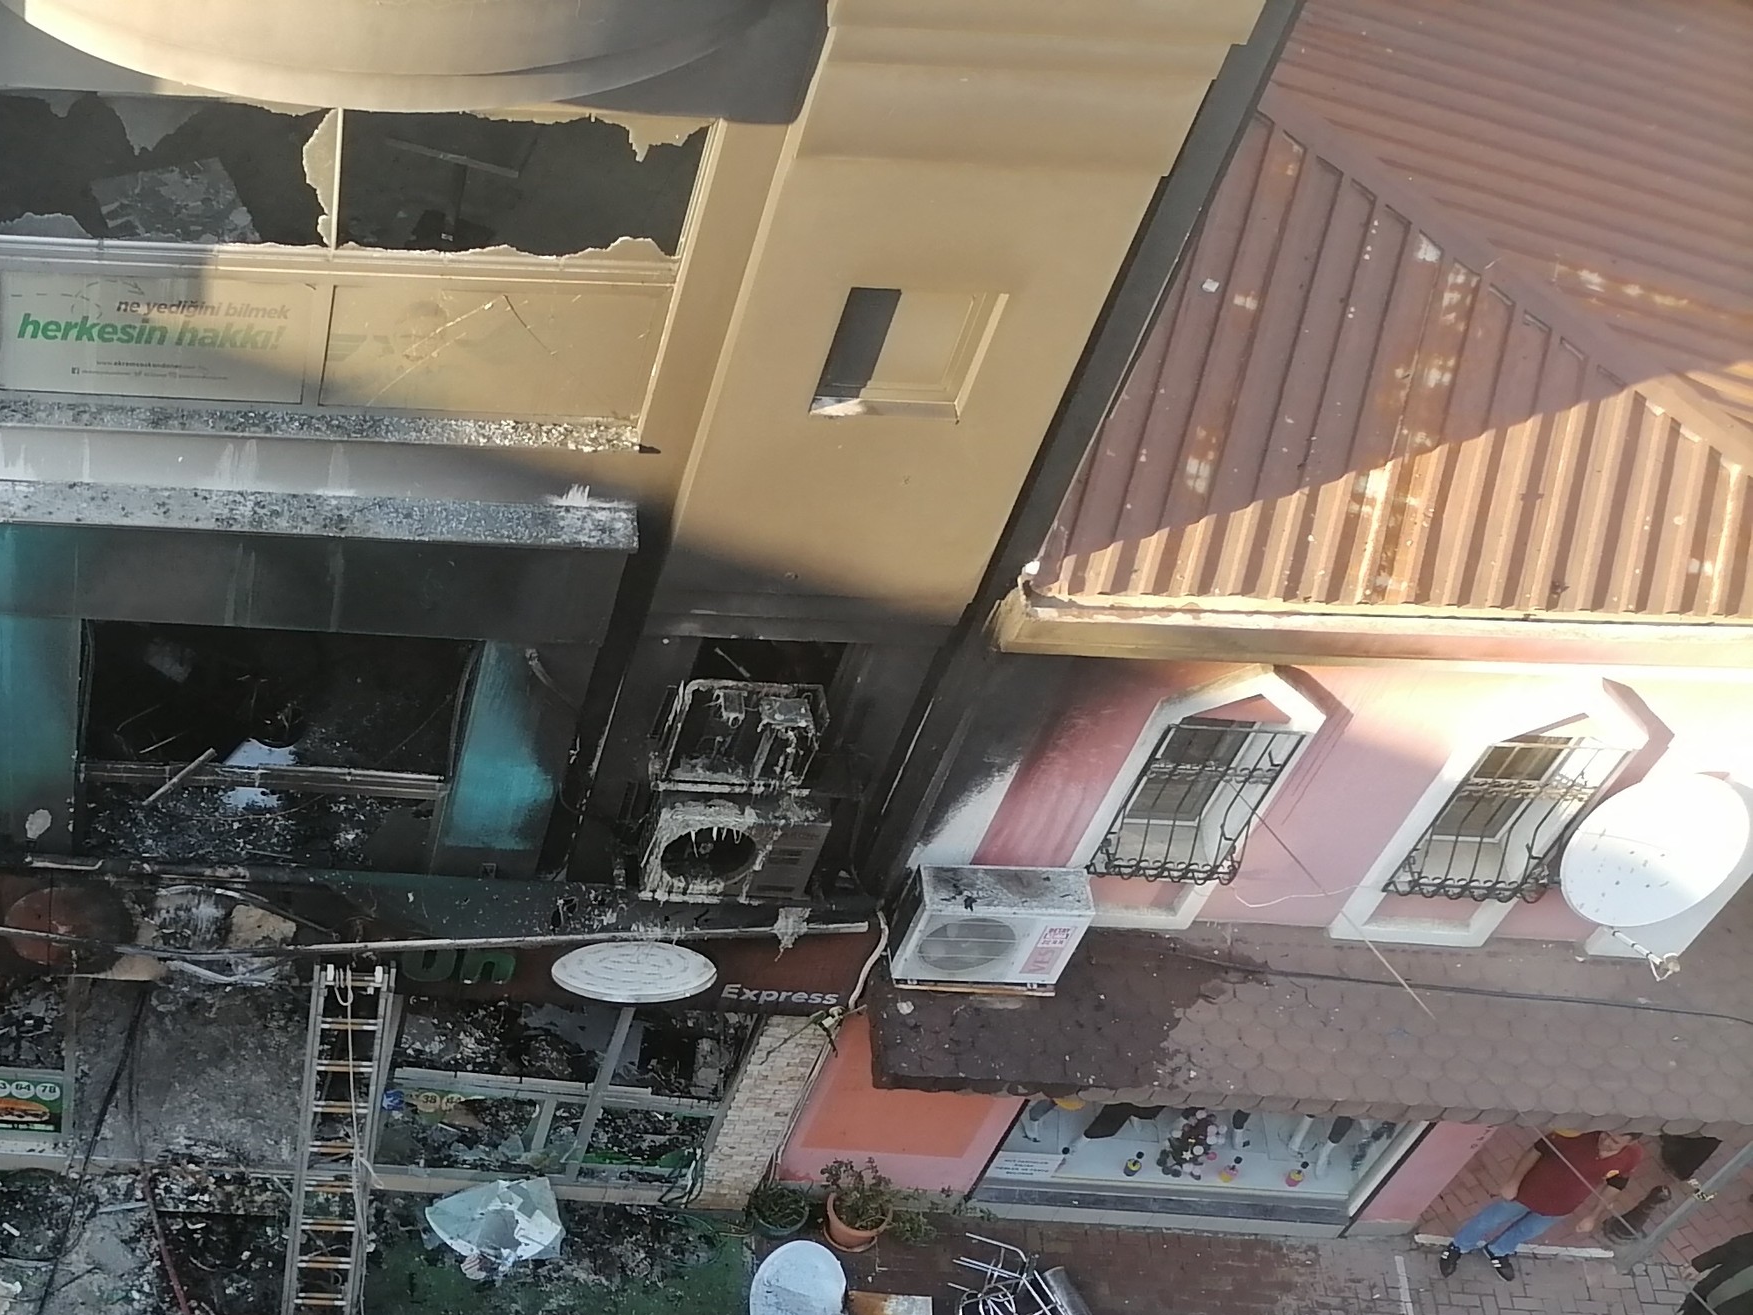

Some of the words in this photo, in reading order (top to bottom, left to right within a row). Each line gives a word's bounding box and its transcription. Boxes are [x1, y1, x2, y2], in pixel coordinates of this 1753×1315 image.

[116, 299, 141, 314] ne
[143, 299, 220, 318] yediğini
[225, 302, 290, 320] bilmek
[17, 312, 169, 346] herkesin
[175, 321, 287, 350] hakkı!
[719, 983, 841, 1005] Express
[41, 1085, 57, 1094] 78
